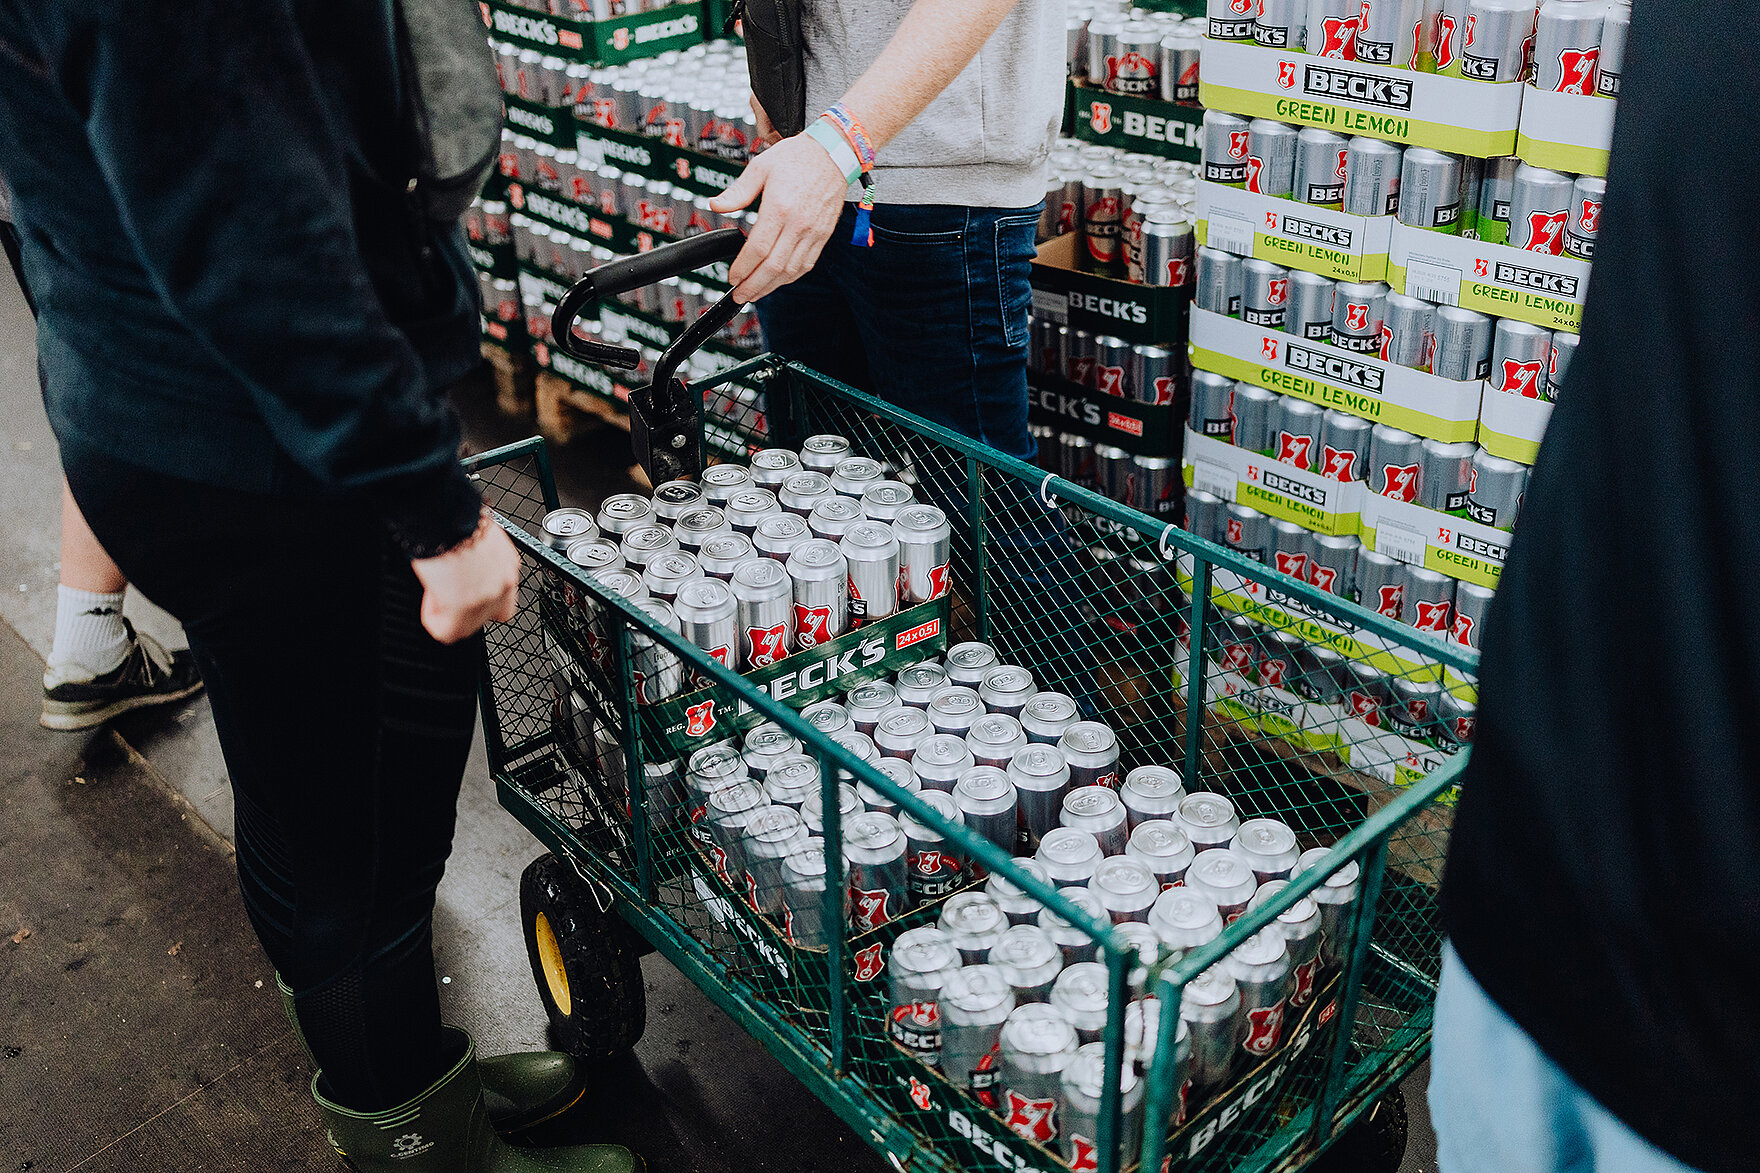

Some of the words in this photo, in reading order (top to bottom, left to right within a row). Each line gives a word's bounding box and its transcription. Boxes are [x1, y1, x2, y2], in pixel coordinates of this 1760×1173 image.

[1307, 69, 1409, 106] BECK'S
[1276, 99, 1336, 125] GREEN
[1344, 110, 1409, 138] LEMON
[1284, 217, 1351, 246] BECK'S
[1263, 235, 1303, 254] GREEN
[1307, 243, 1351, 266] LEMON
[1498, 264, 1579, 294] BECK'S
[1068, 291, 1148, 325] BECK'S
[1472, 284, 1519, 304] GREEN
[1524, 294, 1575, 316] LEMON
[1289, 348, 1382, 390] BECK'S
[1261, 368, 1315, 397] GREEN
[1322, 386, 1381, 416] LEMON
[1246, 485, 1283, 504] GREEN
[1286, 494, 1325, 520] LEMON
[1265, 473, 1325, 503] BECK'S
[1436, 549, 1479, 570] GREEN
[665, 723, 686, 735] REG.
